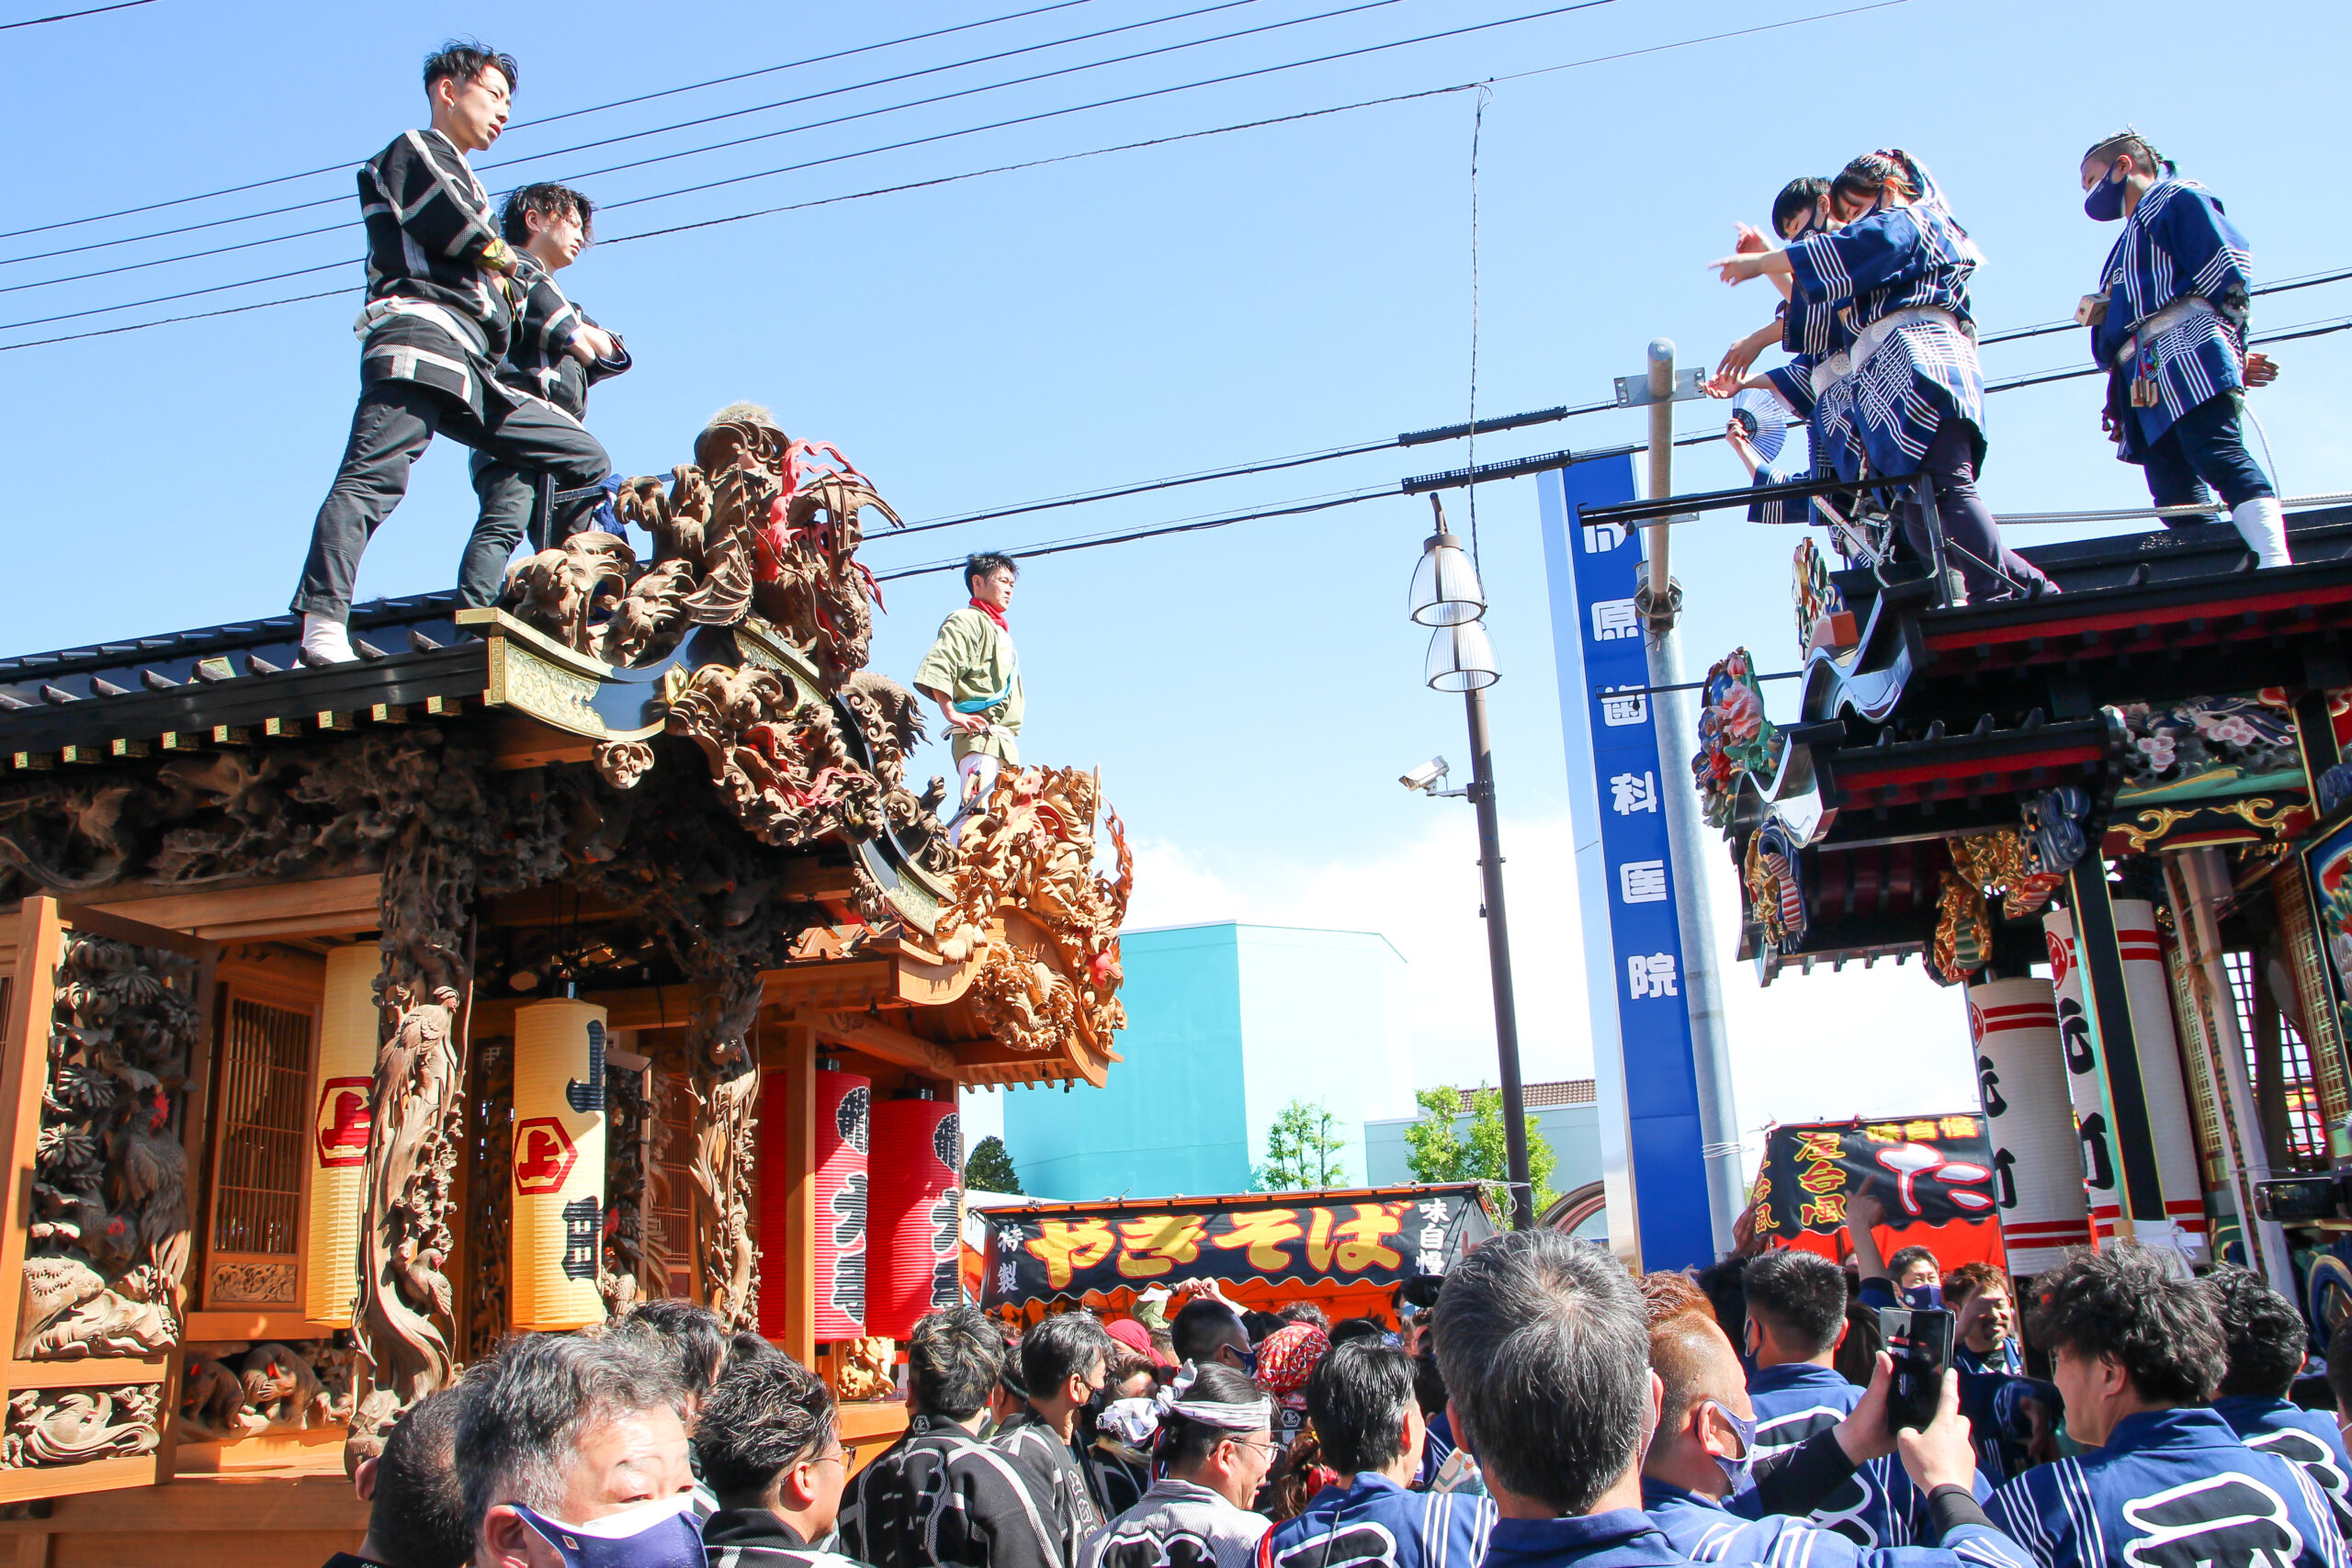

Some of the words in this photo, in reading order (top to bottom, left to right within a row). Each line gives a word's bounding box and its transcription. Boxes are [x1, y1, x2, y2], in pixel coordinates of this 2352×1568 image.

[1794, 1131, 1848, 1226] 屋台風
[997, 1224, 1024, 1294] 特製
[1024, 1200, 1417, 1290] やきそば
[1415, 1198, 1452, 1277] 味自慢
